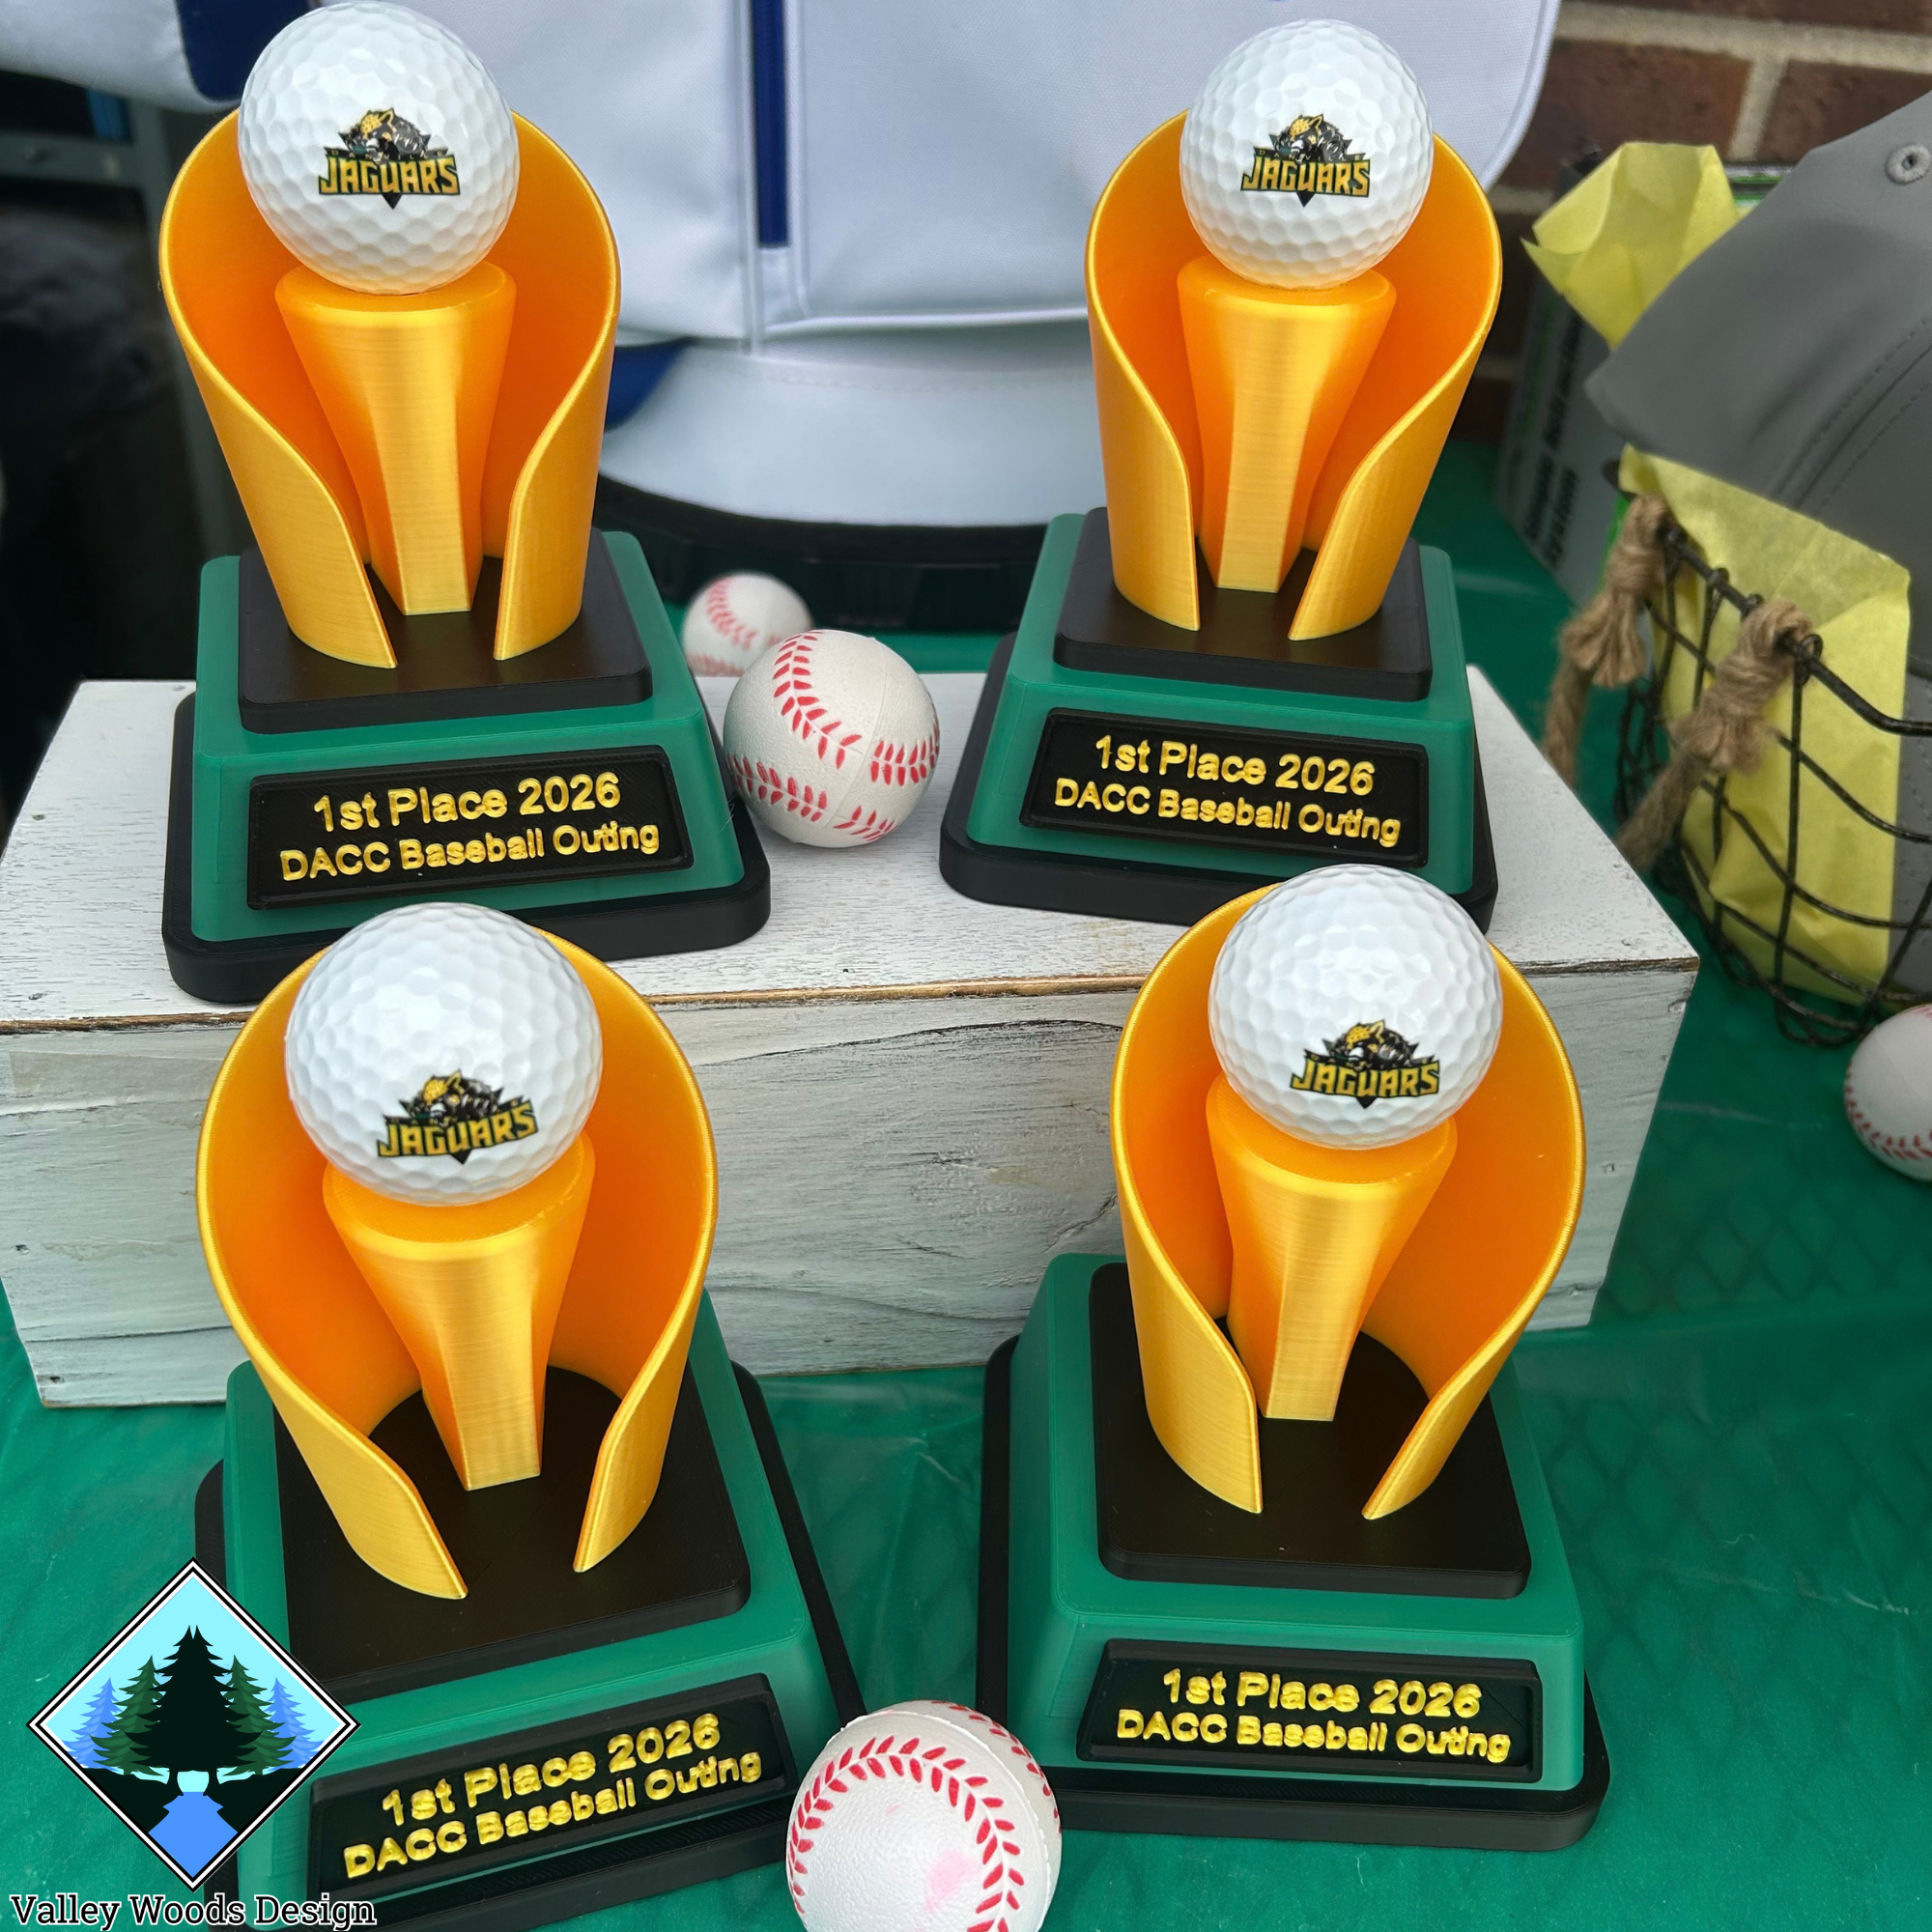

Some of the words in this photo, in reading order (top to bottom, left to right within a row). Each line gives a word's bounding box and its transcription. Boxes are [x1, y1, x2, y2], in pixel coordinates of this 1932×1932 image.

[319, 155, 460, 195] JAGUARS
[1241, 156, 1370, 197] JAGUARS
[1259, 148, 1360, 161] DANVILLE
[1095, 734, 1151, 774] 1st
[1158, 740, 1266, 784] Place
[1274, 753, 1376, 796] 2026
[314, 791, 381, 833] 1st
[387, 786, 508, 826] Place
[518, 772, 621, 816] 2026
[1054, 777, 1151, 815] DACC
[1158, 788, 1292, 831] Baseball
[1297, 803, 1402, 848] Outing
[280, 841, 391, 881] DACC
[399, 827, 544, 869] Baseball
[552, 820, 660, 855] Outing
[1291, 1059, 1439, 1097] JAGUARS
[377, 1099, 538, 1156] JAGUARS
[1163, 1667, 1227, 1706] 1st
[1236, 1671, 1360, 1713] Place
[1369, 1678, 1483, 1719] 2026
[1117, 1709, 1228, 1744] DACC
[1236, 1715, 1388, 1753] Baseball
[1395, 1722, 1512, 1764] Outing
[382, 1777, 456, 1827] 1st
[464, 1750, 596, 1808] Place
[608, 1713, 721, 1774] 2026
[343, 1820, 468, 1879] DACC
[475, 1777, 637, 1845] Baseball
[644, 1751, 762, 1801] Outing
